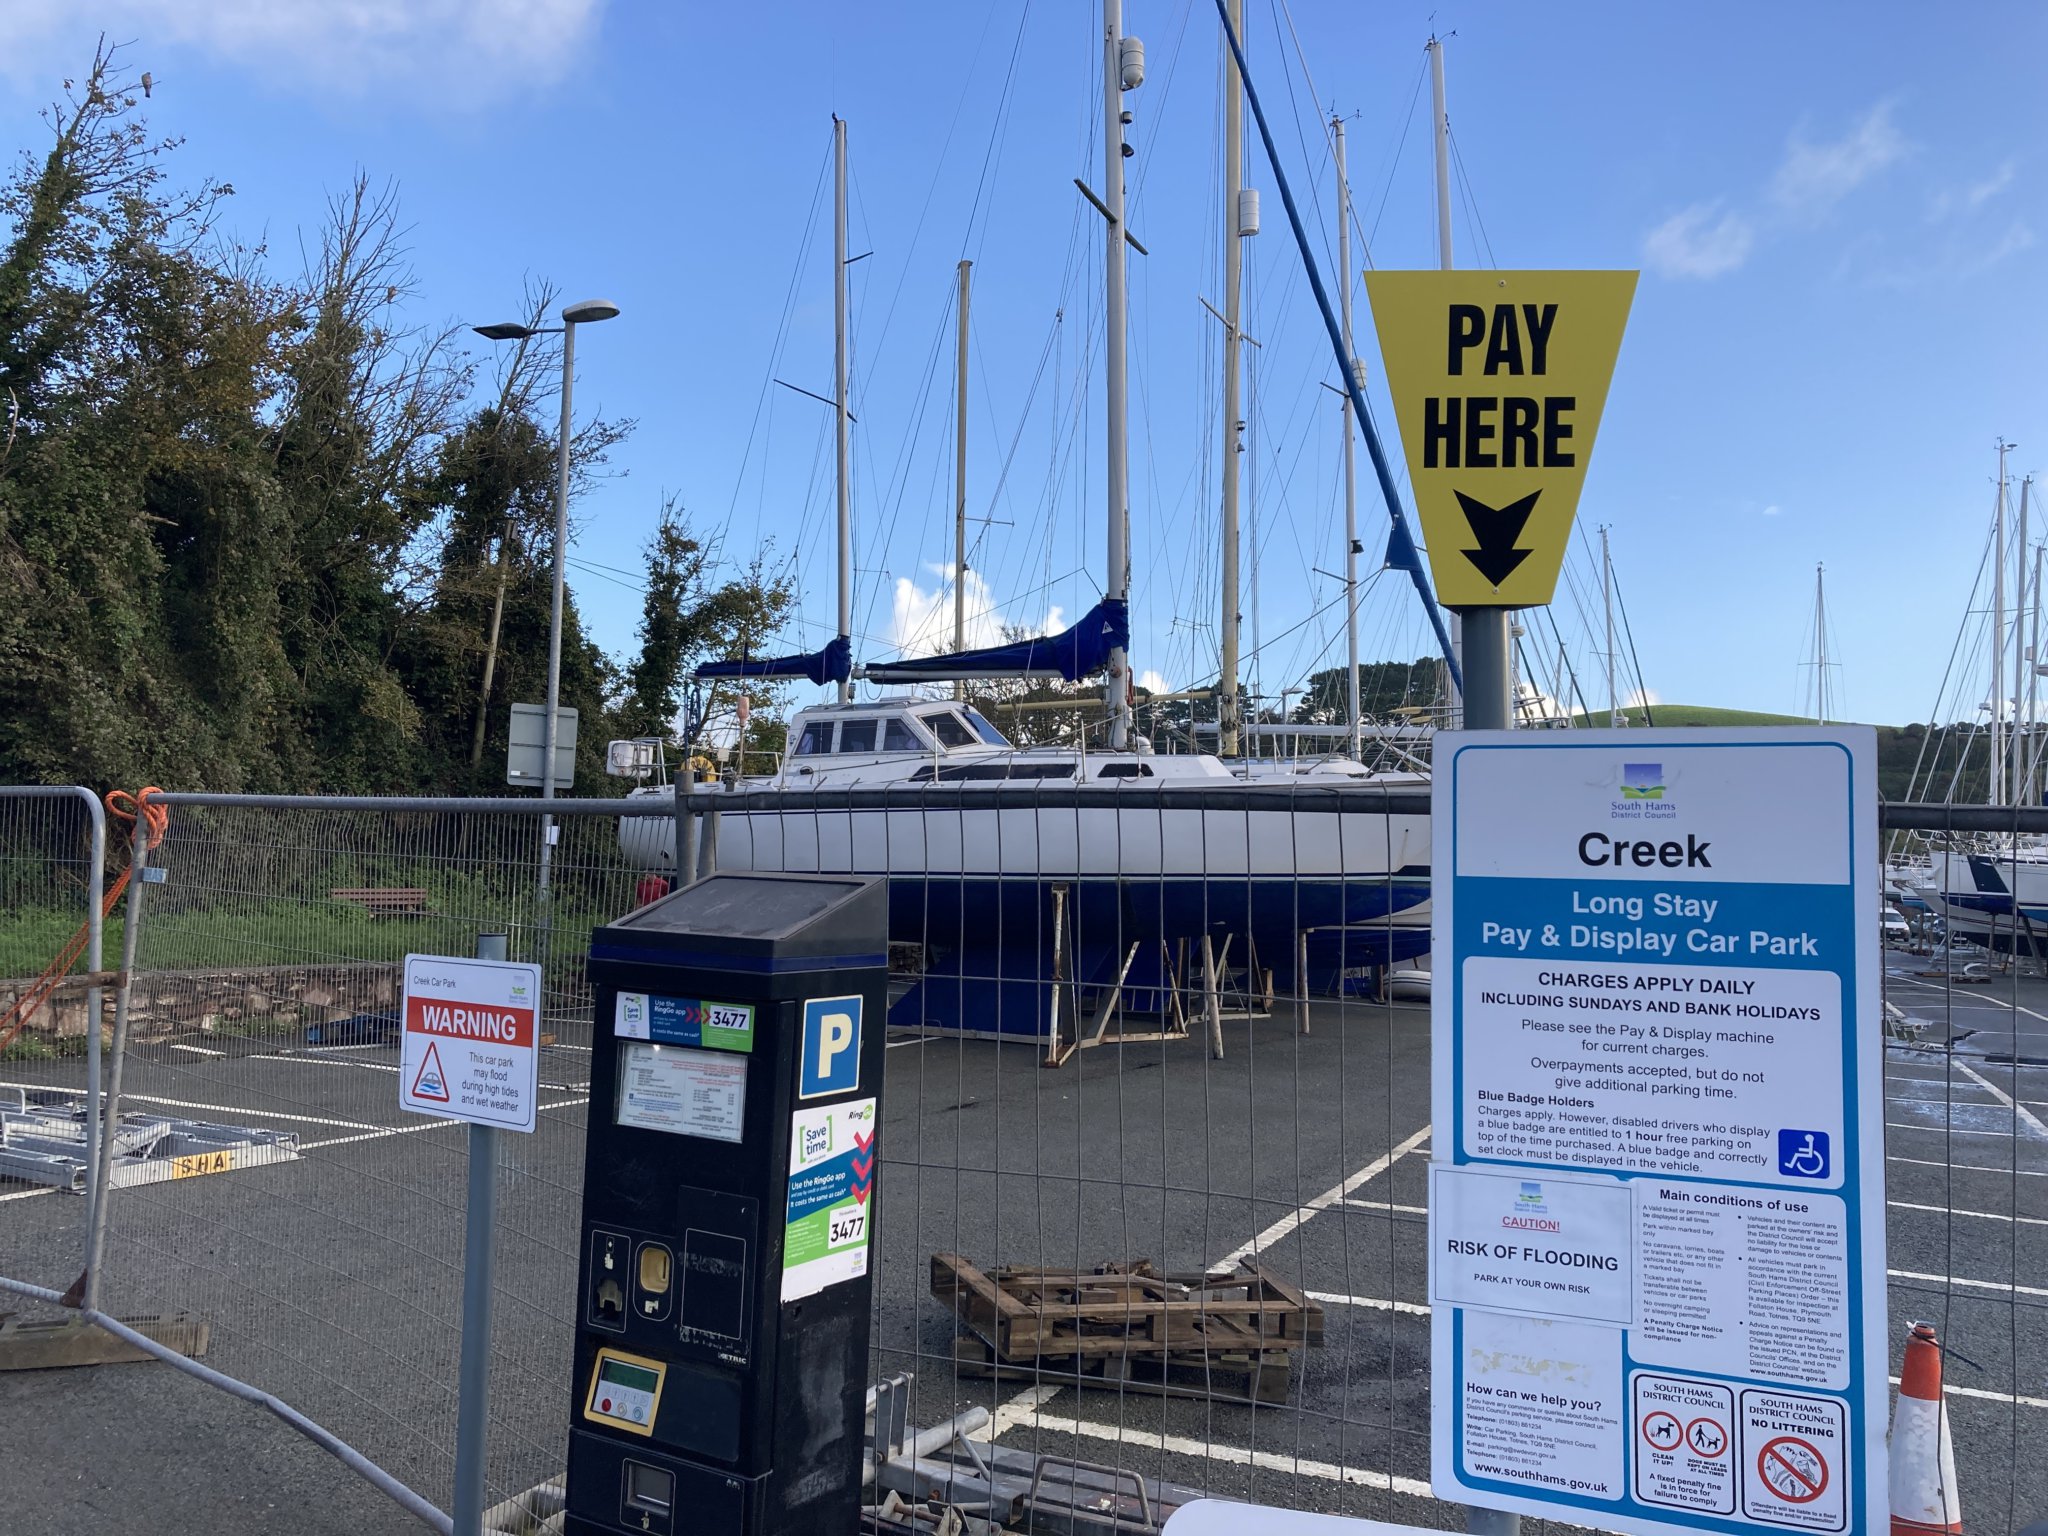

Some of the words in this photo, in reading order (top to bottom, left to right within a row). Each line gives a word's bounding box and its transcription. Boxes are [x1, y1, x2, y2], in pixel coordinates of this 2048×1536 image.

[1448, 304, 1559, 376] PAY
[1423, 397, 1576, 468] HERE
[1611, 802, 1641, 811] South
[1646, 802, 1676, 811] Hams
[1578, 832, 1712, 868] Creek
[1573, 891, 1644, 921] Long
[1653, 892, 1718, 923] Stay
[1482, 922, 1532, 951] Pay
[1541, 924, 1560, 947] &
[1570, 925, 1677, 957] Display
[1686, 929, 1740, 953] Car
[1750, 931, 1819, 956] Park
[413, 975, 431, 986] Creek
[431, 977, 442, 987] Car
[443, 978, 456, 989] Park
[1538, 972, 1629, 989] CHARGES
[1633, 976, 1694, 992] APPLY
[1700, 979, 1755, 995] DAILY
[1481, 992, 1564, 1008] INCLUDING
[1568, 997, 1643, 1012] SUNDAYS
[1646, 1001, 1680, 1013] AND
[1685, 1002, 1731, 1016] BANK
[1736, 1005, 1821, 1021] HOLIDAYS
[422, 1005, 516, 1041] WARNING
[712, 1010, 747, 1028] 3477
[1522, 1019, 1565, 1032] Please
[1568, 1023, 1592, 1034] see
[1595, 1023, 1616, 1035] the
[1620, 1024, 1645, 1039] Pay
[1649, 1026, 1658, 1038] &
[1663, 1027, 1712, 1043] Display
[1716, 1031, 1774, 1044] machine
[818, 1012, 854, 1080] P
[1582, 1040, 1599, 1051] for
[1602, 1042, 1648, 1054] current
[1652, 1044, 1709, 1059] charges.
[469, 1051, 484, 1064] This
[485, 1055, 497, 1065] car
[498, 1055, 514, 1068] park
[473, 1068, 489, 1080] may
[490, 1068, 508, 1081] flood
[1531, 1057, 1624, 1074] Overpayments
[1628, 1066, 1691, 1079] accepted,
[1696, 1068, 1717, 1080] but
[1721, 1069, 1738, 1081] do
[1743, 1071, 1765, 1083] not
[461, 1080, 483, 1095] during
[485, 1082, 500, 1097] high
[501, 1084, 519, 1098] tides
[1555, 1077, 1581, 1089] give
[1585, 1079, 1647, 1093] additional
[1652, 1082, 1700, 1099] parking
[1704, 1085, 1737, 1099] time.
[461, 1094, 474, 1105] and
[476, 1097, 489, 1108] wet
[490, 1099, 519, 1112] weather
[1478, 1090, 1504, 1101] Blue
[1507, 1092, 1545, 1106] Badge
[1548, 1095, 1594, 1108] Holders
[1478, 1105, 1521, 1118] Charges
[1524, 1110, 1555, 1122] apply.
[1559, 1112, 1609, 1126] However,
[1612, 1116, 1658, 1129] disabled
[1661, 1120, 1699, 1132] drivers
[1702, 1123, 1726, 1133] who
[1729, 1125, 1771, 1139] display
[806, 1125, 827, 1142] Save
[1487, 1119, 1509, 1129] blue
[1513, 1121, 1545, 1134] badge
[1548, 1126, 1566, 1134] are
[1569, 1127, 1608, 1138] entitled
[1612, 1129, 1622, 1139] to
[1625, 1130, 1631, 1139] 1
[1636, 1131, 1663, 1142] hour
[1666, 1134, 1688, 1144] free
[1691, 1137, 1733, 1150] parking
[1737, 1140, 1751, 1149] on
[806, 1139, 827, 1156] time
[1478, 1132, 1494, 1142] top
[1497, 1133, 1508, 1142] of
[1510, 1134, 1526, 1143] the
[1529, 1136, 1552, 1146] time
[1555, 1140, 1614, 1152] purchased.
[1617, 1143, 1626, 1152] A
[1629, 1144, 1652, 1154] blue
[1655, 1146, 1690, 1159] badge
[1693, 1150, 1715, 1160] and
[1718, 1153, 1768, 1166] correctly
[1478, 1145, 1493, 1154] set
[1497, 1146, 1523, 1157] clock
[1527, 1150, 1552, 1160] must
[1555, 1151, 1568, 1161] be
[1571, 1153, 1623, 1167] displayed
[1626, 1157, 1636, 1166] in
[1639, 1158, 1657, 1168] the
[1660, 1160, 1703, 1173] vehicle.
[791, 1179, 803, 1191] Use
[803, 1177, 813, 1188] the
[813, 1174, 834, 1188] RingGo
[834, 1172, 846, 1184] app
[1660, 1189, 1690, 1202] Main
[1694, 1194, 1763, 1209] conditions
[1767, 1199, 1782, 1210] of
[1784, 1204, 1809, 1213] use
[830, 1216, 864, 1243] 3477
[1502, 1216, 1560, 1231] CAUTION!
[1448, 1239, 1489, 1257] RISK
[1494, 1245, 1517, 1260] OF
[1523, 1248, 1618, 1271] FLOODING
[1474, 1273, 1499, 1283] PARK
[1501, 1277, 1513, 1285] AT
[1515, 1278, 1542, 1288] YOUR
[1543, 1282, 1566, 1292] OWN
[1568, 1284, 1590, 1294] RISK
[1467, 1381, 1493, 1395] How
[1496, 1388, 1517, 1399] can
[1520, 1392, 1538, 1402] we
[1541, 1393, 1567, 1408] help
[1570, 1399, 1601, 1412] you?
[1643, 1391, 1681, 1403] DISTRICT
[1684, 1396, 1725, 1409] COUNCIL
[1653, 1383, 1685, 1395] SOUTH
[1687, 1388, 1713, 1399] HAMS
[1749, 1406, 1791, 1418] DISTRICT
[1792, 1412, 1836, 1425] COUNCIL
[1760, 1398, 1793, 1410] SOUTH
[1796, 1403, 1823, 1414] HAMS
[1751, 1419, 1768, 1428] NO
[1771, 1422, 1834, 1438] LITTERING
[1652, 1452, 1674, 1461] CLEAN
[1474, 1462, 1608, 1493] www.southhams.gov.uk
[1657, 1474, 1676, 1483] fixed
[1677, 1476, 1705, 1489] penalty
[1707, 1481, 1722, 1491] fine
[1654, 1489, 1678, 1499] failure
[1689, 1496, 1718, 1507] comply
[1678, 1484, 1698, 1495] force
[1700, 1488, 1711, 1497] for
